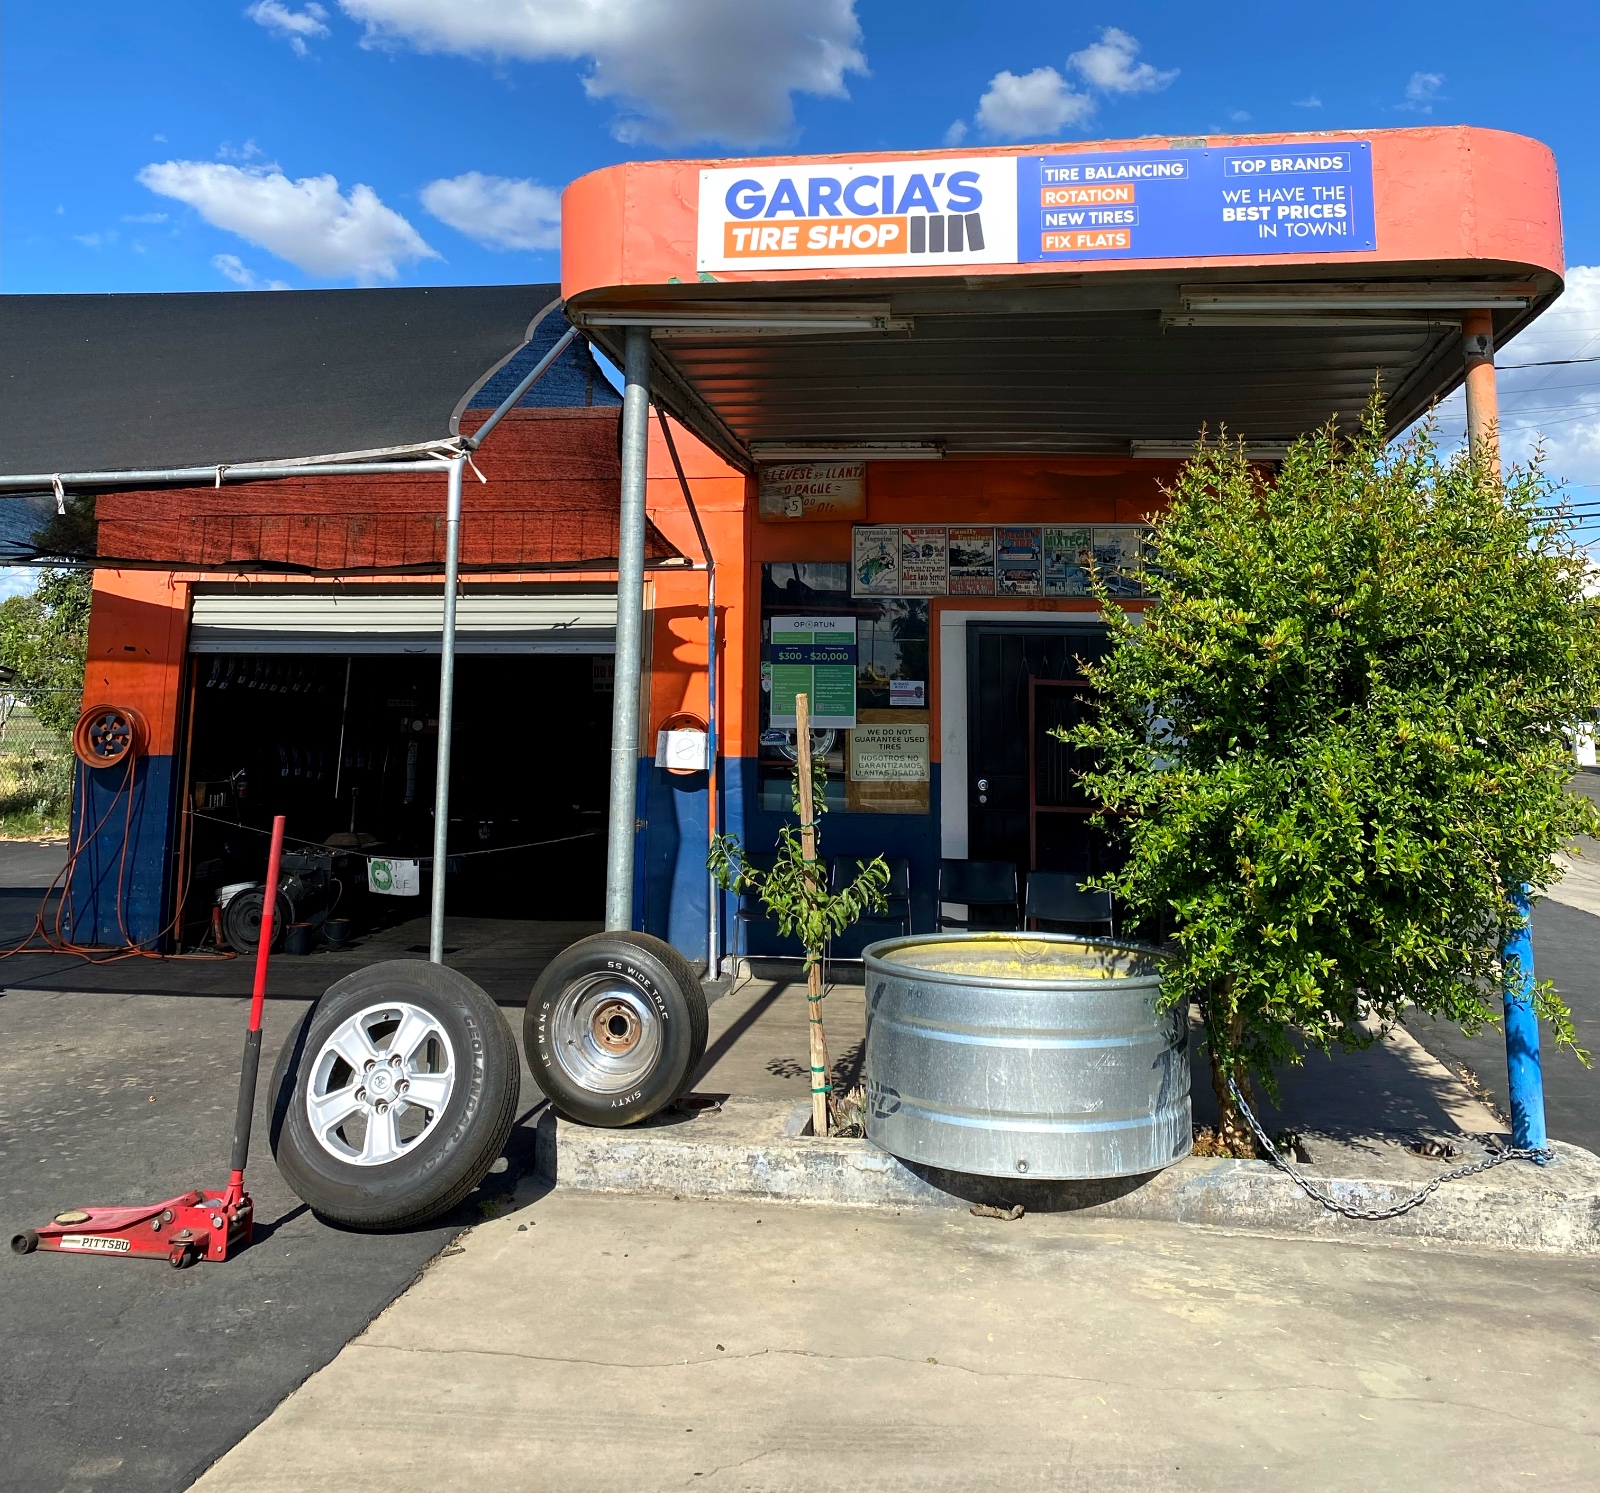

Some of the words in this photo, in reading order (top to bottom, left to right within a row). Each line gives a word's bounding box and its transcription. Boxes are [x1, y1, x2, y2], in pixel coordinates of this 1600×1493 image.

[1045, 167, 1079, 182] TIRE
[1085, 163, 1184, 180] BALANCING
[1231, 159, 1268, 174] TOP
[1271, 156, 1344, 171] BRANDS
[725, 171, 983, 219] GARCIA'S
[1045, 188, 1128, 204] ROTATION
[1222, 189, 1251, 204] WE
[1258, 187, 1305, 202] HAVE
[1312, 186, 1346, 201] THE
[1045, 212, 1085, 226] NEW
[1088, 210, 1135, 225] TIRES
[1222, 206, 1272, 222] BEST
[1277, 204, 1347, 220] PRICES
[731, 226, 800, 251] TIRE
[806, 223, 899, 249] SHOP
[1259, 224, 1277, 238] IN
[1284, 221, 1348, 237] TOWN!
[1045, 235, 1071, 249] FIX
[1077, 233, 1126, 247] FLATS
[825, 467, 865, 479] LLANTA
[795, 483, 831, 495] PAGUE
[1045, 535, 1089, 546] MIXTECA
[794, 620, 835, 629] OPORTUN
[778, 651, 802, 661] $300
[810, 651, 849, 662] $20,000
[607, 961, 623, 970] SS
[627, 966, 651, 988] WIDE
[652, 989, 669, 1020] TRAC
[538, 1002, 550, 1044] MANS
[541, 1053, 551, 1067] LE
[451, 1015, 484, 1144] GEOLANDAR
[611, 1090, 642, 1108] SIXTY
[81, 1238, 129, 1251] PITTSBU
